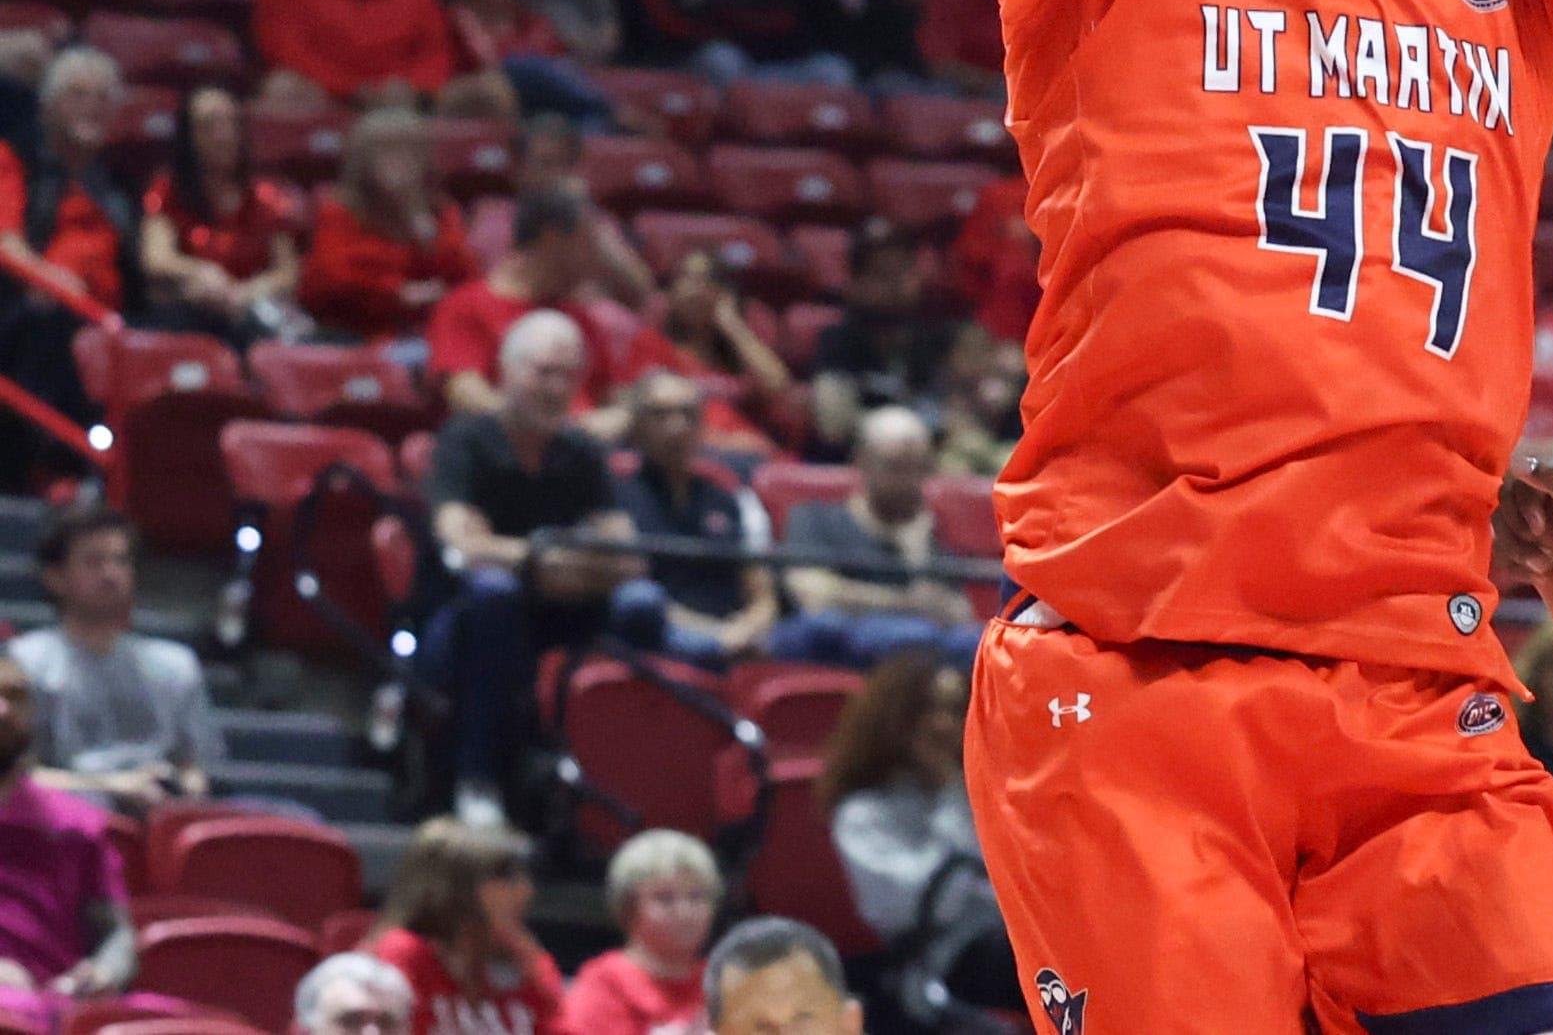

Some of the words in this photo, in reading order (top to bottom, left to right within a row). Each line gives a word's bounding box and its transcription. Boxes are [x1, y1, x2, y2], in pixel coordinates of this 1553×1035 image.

[1201, 4, 1286, 94] UT
[1306, 10, 1514, 136] MARTIN
[1247, 124, 1479, 361] 44
